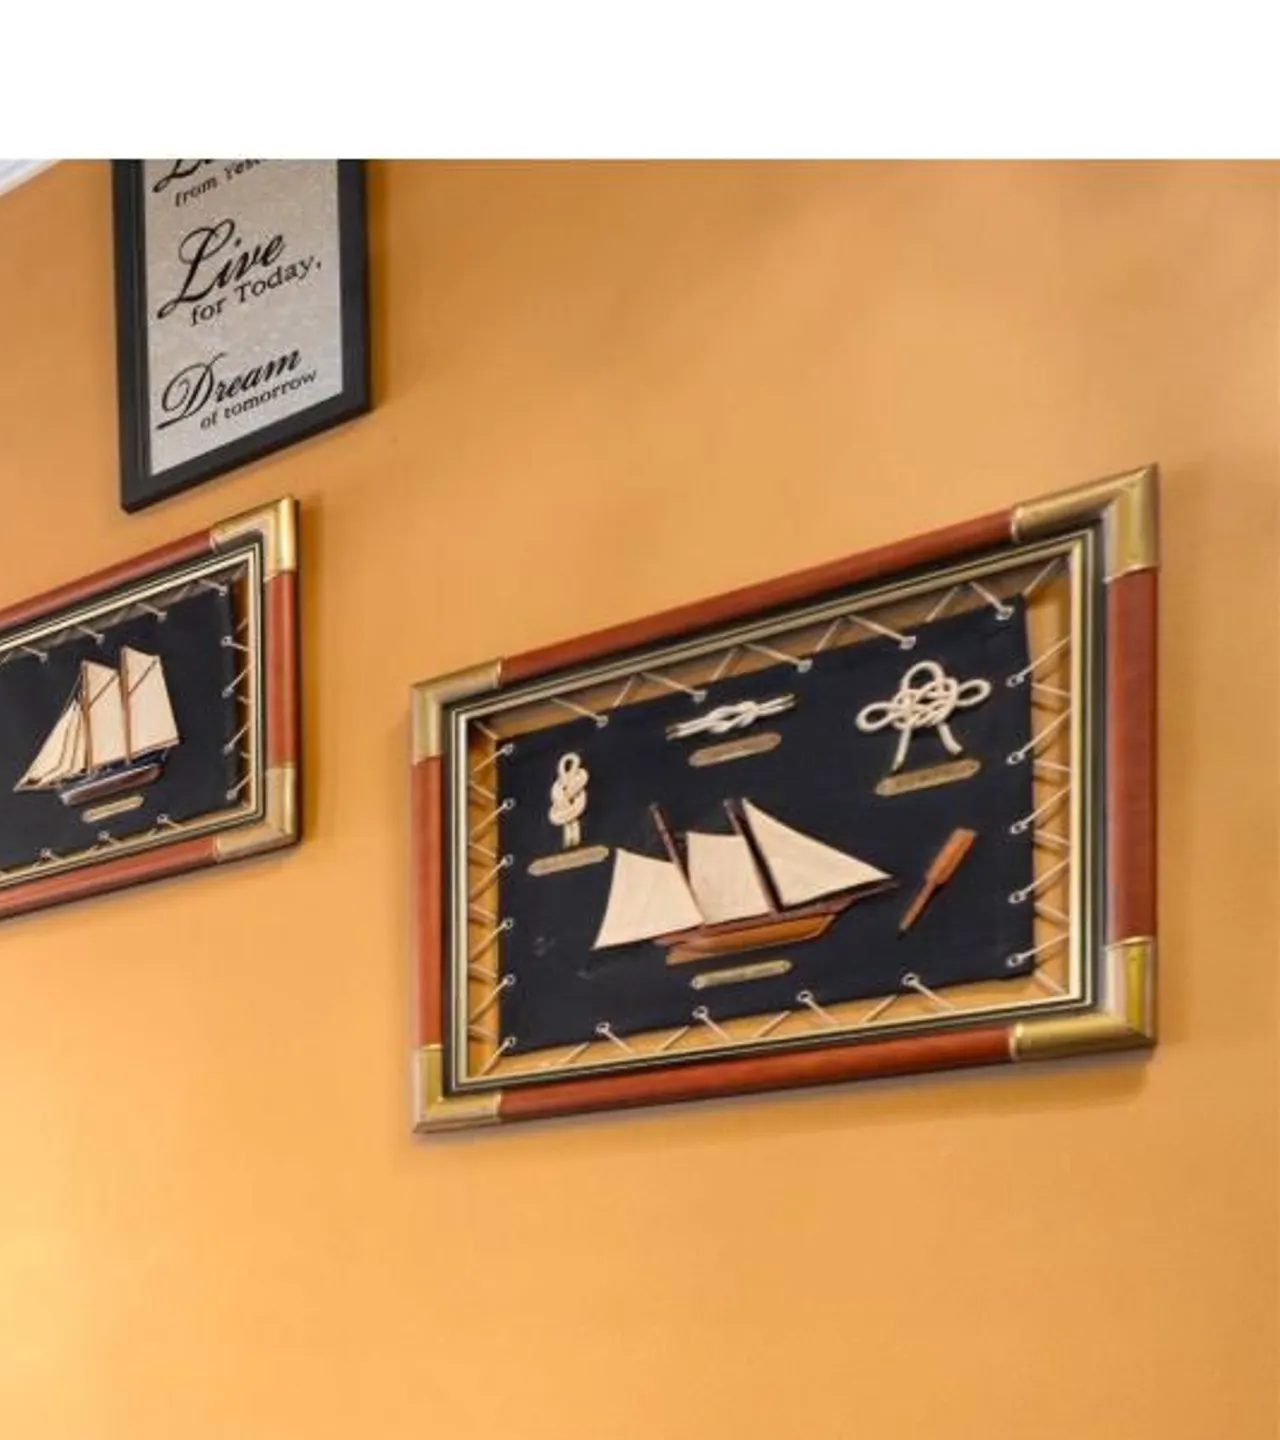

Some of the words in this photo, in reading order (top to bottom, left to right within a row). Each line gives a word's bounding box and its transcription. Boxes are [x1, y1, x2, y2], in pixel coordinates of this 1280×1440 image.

[175, 176, 218, 207] from
[156, 218, 285, 319] Live
[191, 297, 227, 327] for
[234, 255, 322, 304] Today,
[155, 350, 302, 430] Dream
[200, 411, 219, 430] of
[224, 369, 318, 419] tomorrow
